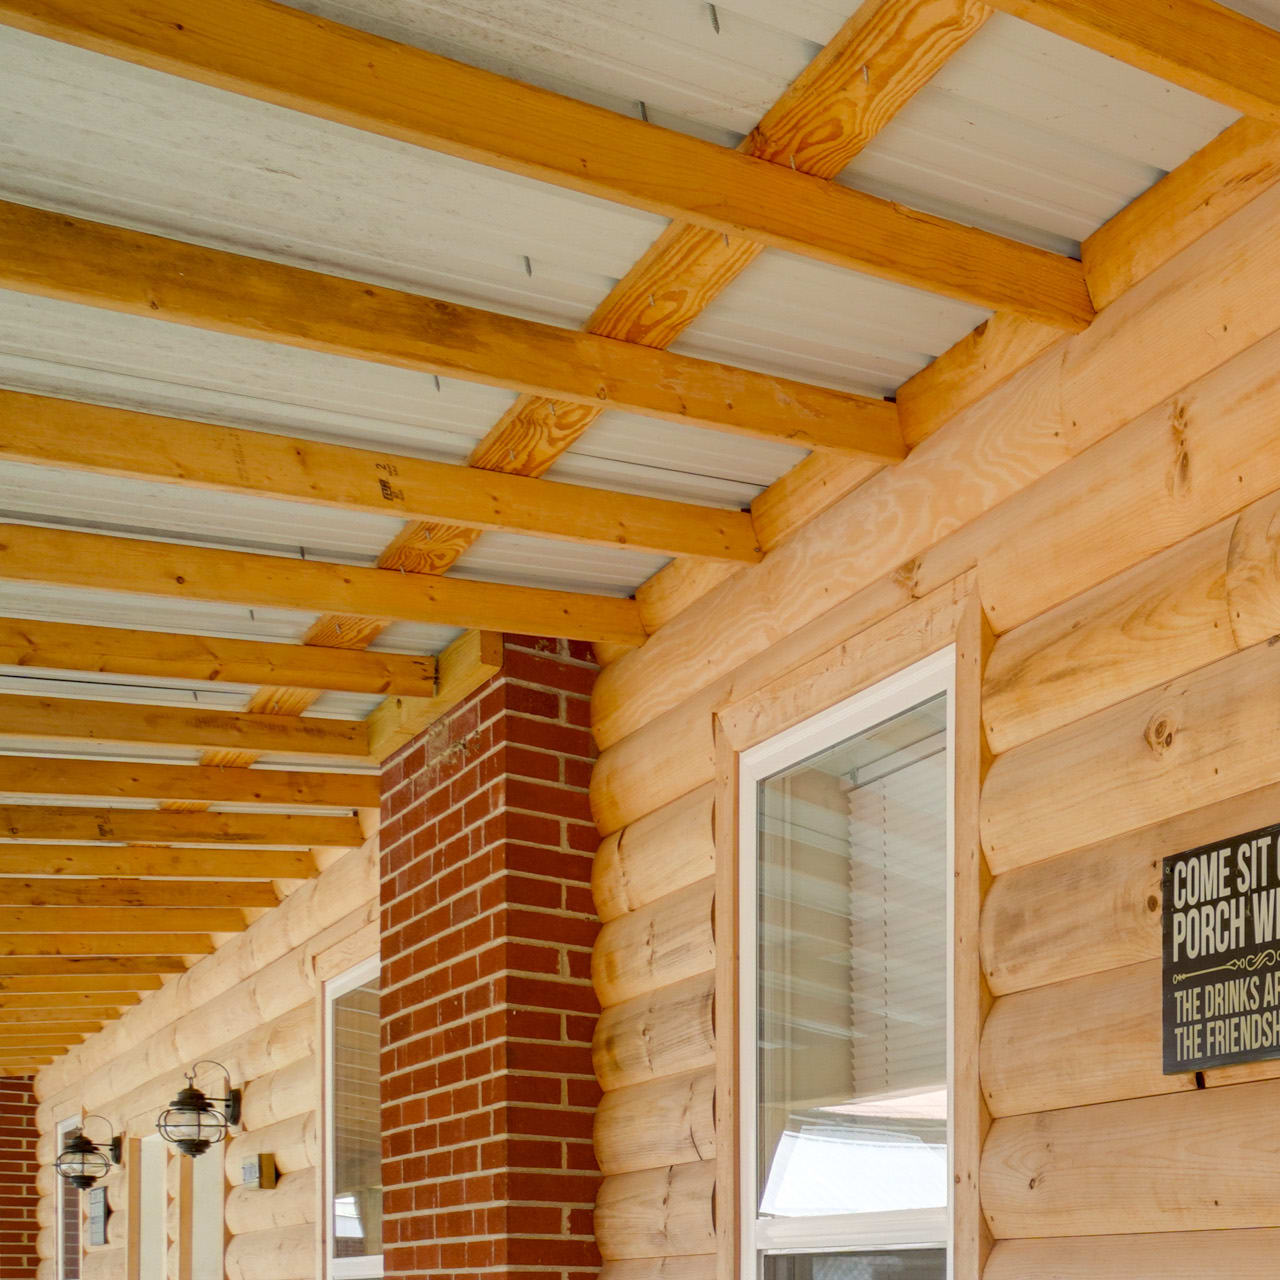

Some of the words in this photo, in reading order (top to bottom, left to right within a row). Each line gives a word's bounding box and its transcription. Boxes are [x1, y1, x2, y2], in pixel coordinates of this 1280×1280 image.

[1173, 847, 1231, 909] COME
[1236, 836, 1271, 893] SIT
[1173, 896, 1245, 962] PORCH
[1174, 987, 1201, 1024] THE
[1204, 975, 1259, 1019] DRINKS
[1174, 1024, 1202, 1062] THE
